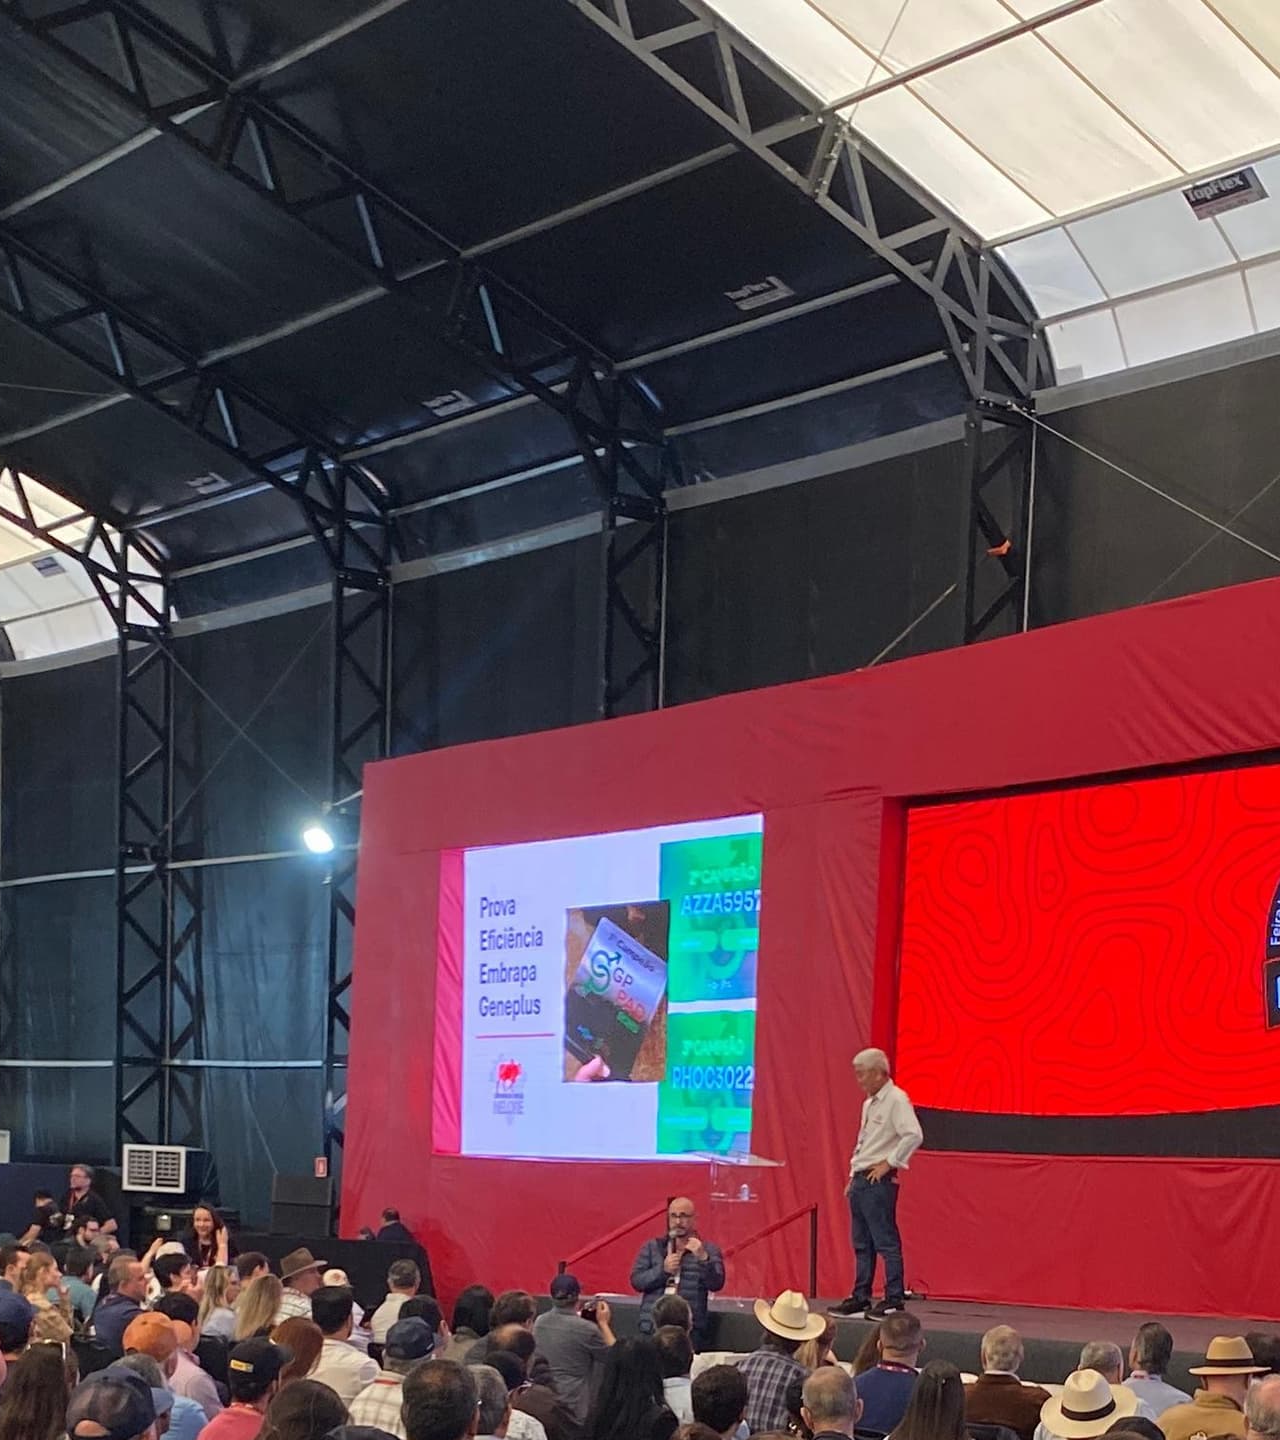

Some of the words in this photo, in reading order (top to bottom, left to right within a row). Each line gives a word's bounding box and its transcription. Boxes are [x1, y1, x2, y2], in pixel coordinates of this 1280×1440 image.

[480, 898, 516, 919] Prova
[480, 925, 543, 951] Eficiência
[480, 963, 537, 987] Embrapa
[479, 996, 541, 1021] Geneplus
